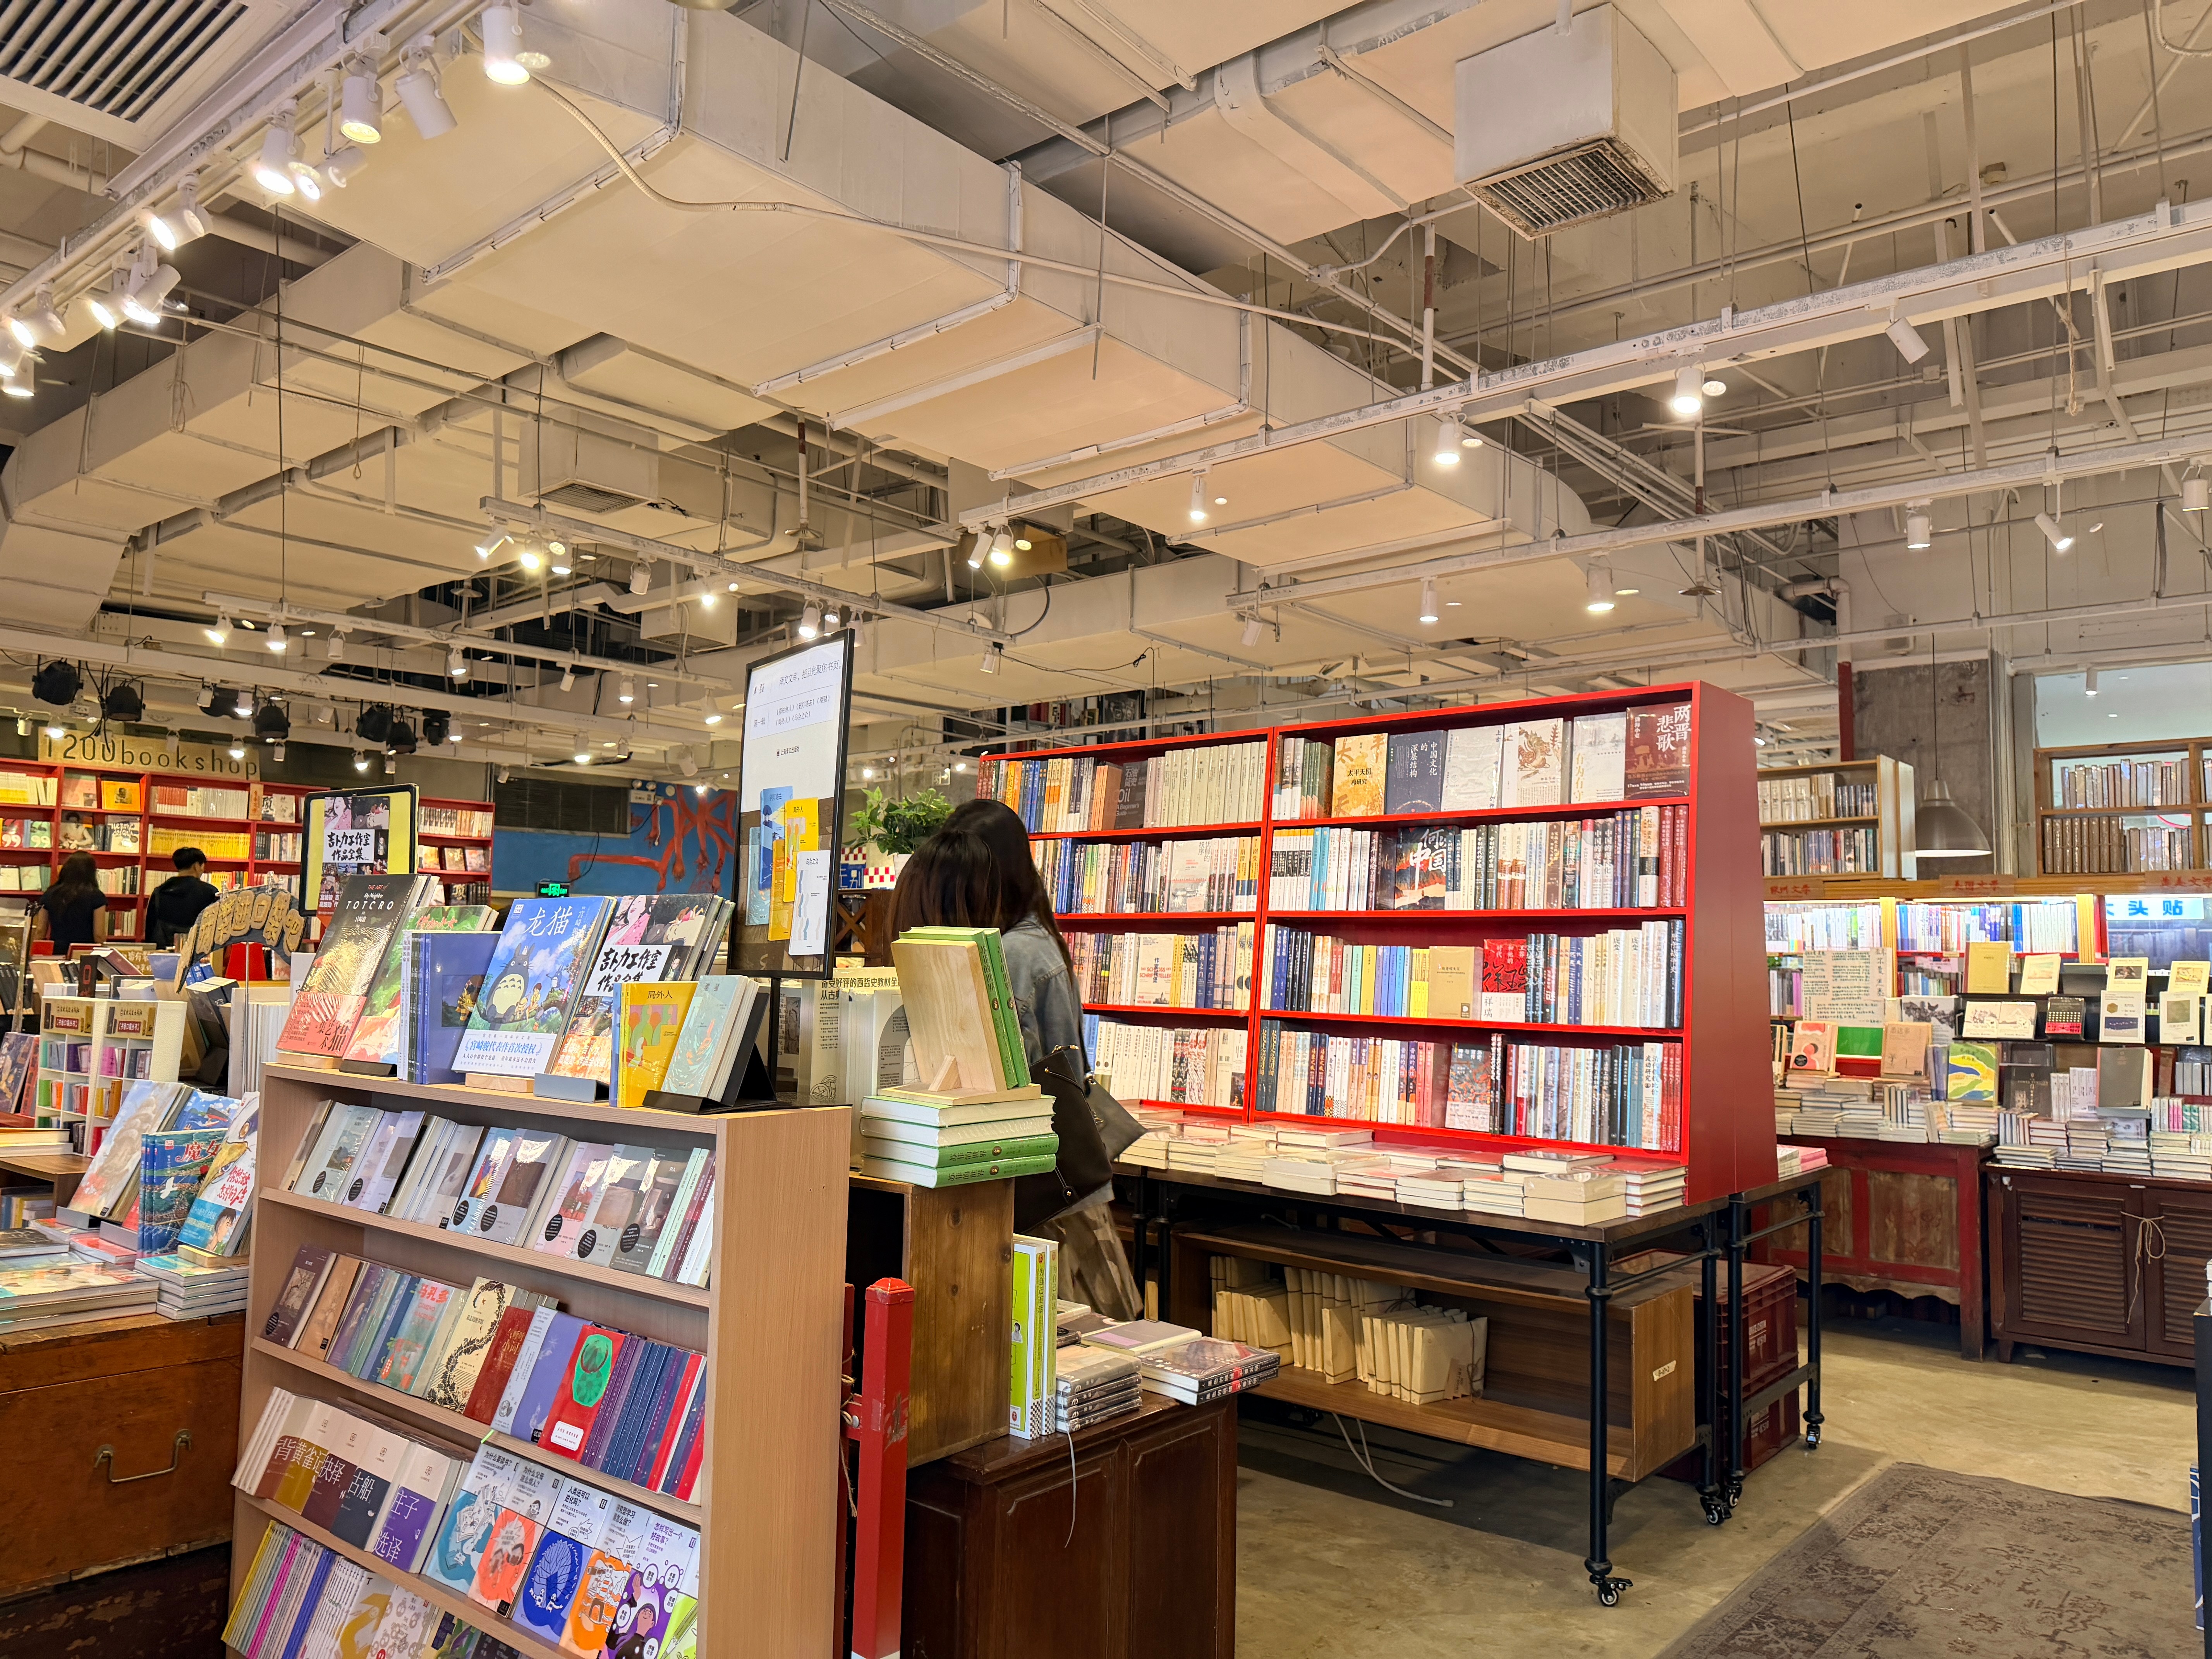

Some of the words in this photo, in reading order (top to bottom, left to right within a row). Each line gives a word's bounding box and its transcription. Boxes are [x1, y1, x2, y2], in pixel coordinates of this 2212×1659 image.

[1656, 715, 1676, 752] 悲歌
[1671, 705, 1692, 742] 两晋
[1420, 743, 1428, 752] 的
[1429, 741, 1437, 776] 中国文化
[1347, 768, 1372, 777] 太平天国
[1409, 744, 1419, 778] 深层结构
[331, 847, 365, 862] 作品全集
[522, 905, 573, 936] 龙猫
[599, 947, 663, 972] 吉卜力工作室
[647, 990, 673, 999] 局外人
[1484, 996, 1493, 1018] 祥瑞
[469, 1040, 537, 1054] 宫崎骏代表作首次授权
[175, 1140, 222, 1163] 魔女
[274, 1437, 296, 1462] 背
[291, 1441, 328, 1475] 黄雀记
[319, 1456, 346, 1485] 抉择
[347, 1471, 374, 1502] 古船
[567, 1486, 591, 1501] 人类还可以
[390, 1490, 418, 1520] 庄子
[650, 1531, 669, 1546] 好故事？
[654, 1522, 683, 1540] 怎样写出一个
[373, 1530, 402, 1563] 选译
